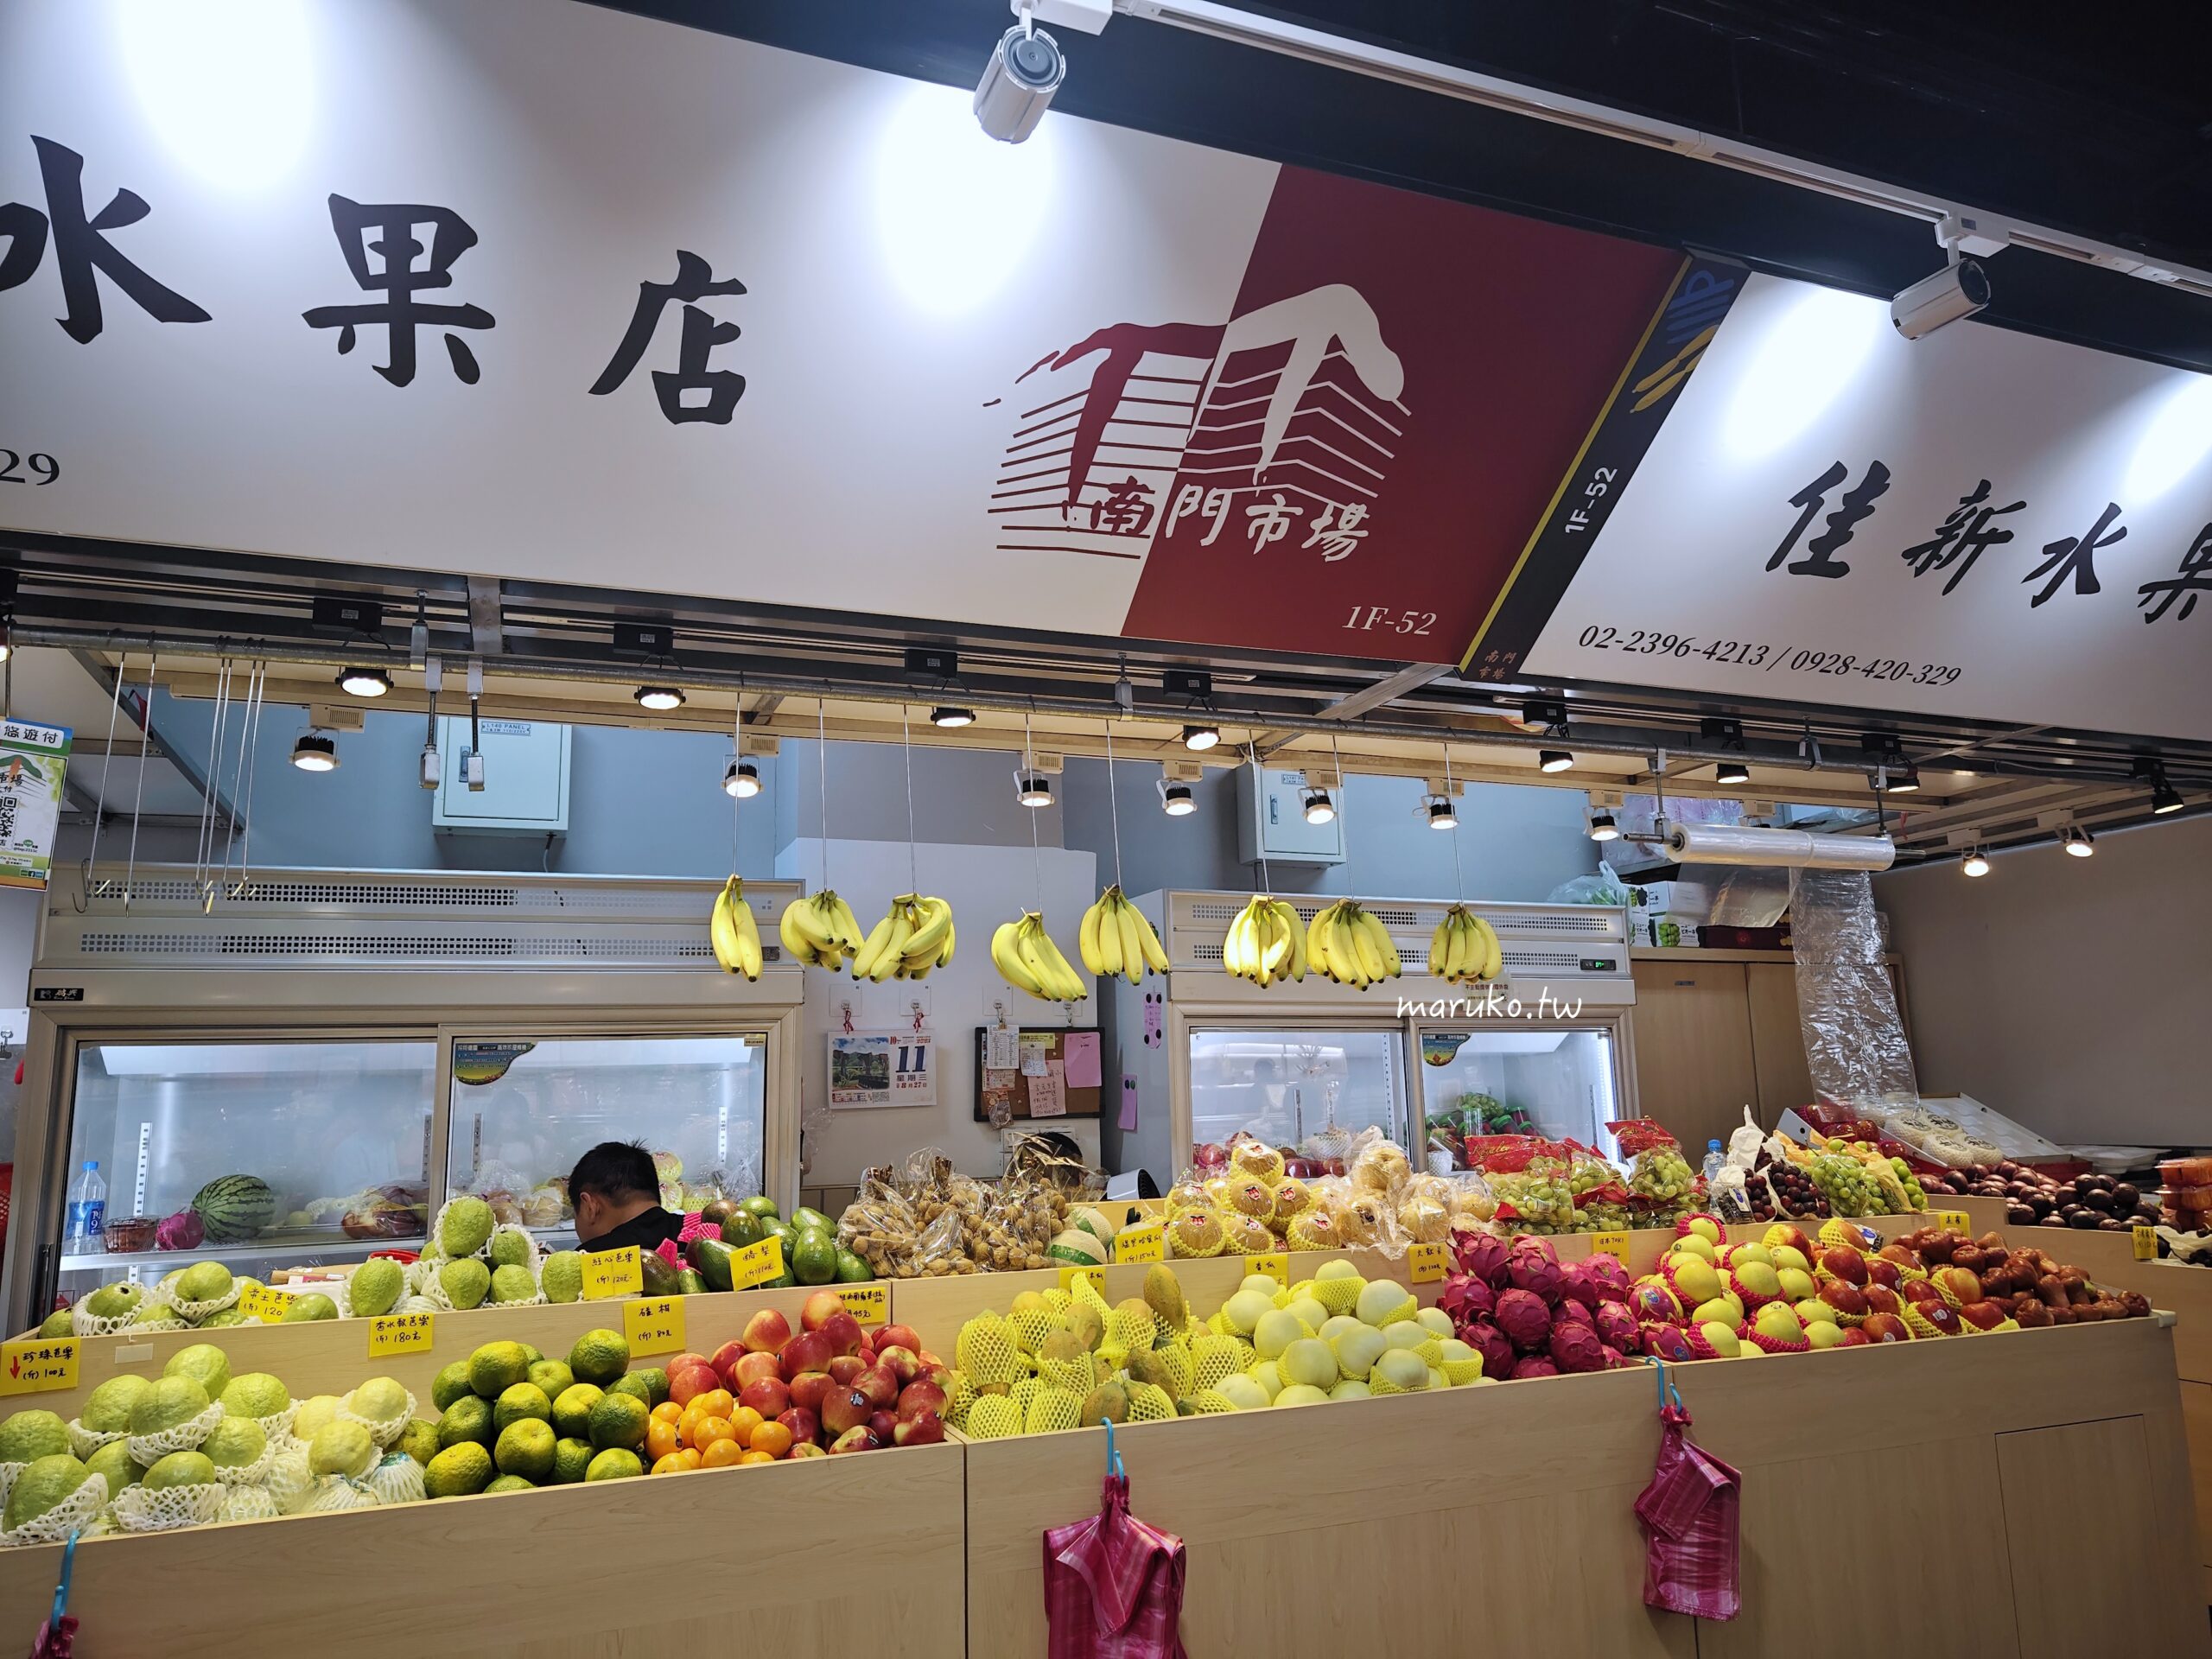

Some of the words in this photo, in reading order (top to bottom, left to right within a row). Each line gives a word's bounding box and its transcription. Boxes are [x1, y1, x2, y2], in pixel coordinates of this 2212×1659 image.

[0, 134, 747, 425] 水果店
[1564, 465, 1618, 537] 1F-52
[1090, 475, 1371, 563] 南門市場
[1341, 605, 1437, 636] 1F-52
[1579, 625, 1770, 666] 02-2396-4213
[1789, 650, 1962, 687] 0928-420-329
[3, 724, 59, 744] 悠遊付
[895, 1045, 926, 1073] 11
[743, 1244, 771, 1262] 酪梨
[1255, 1261, 1276, 1271] 香瓜
